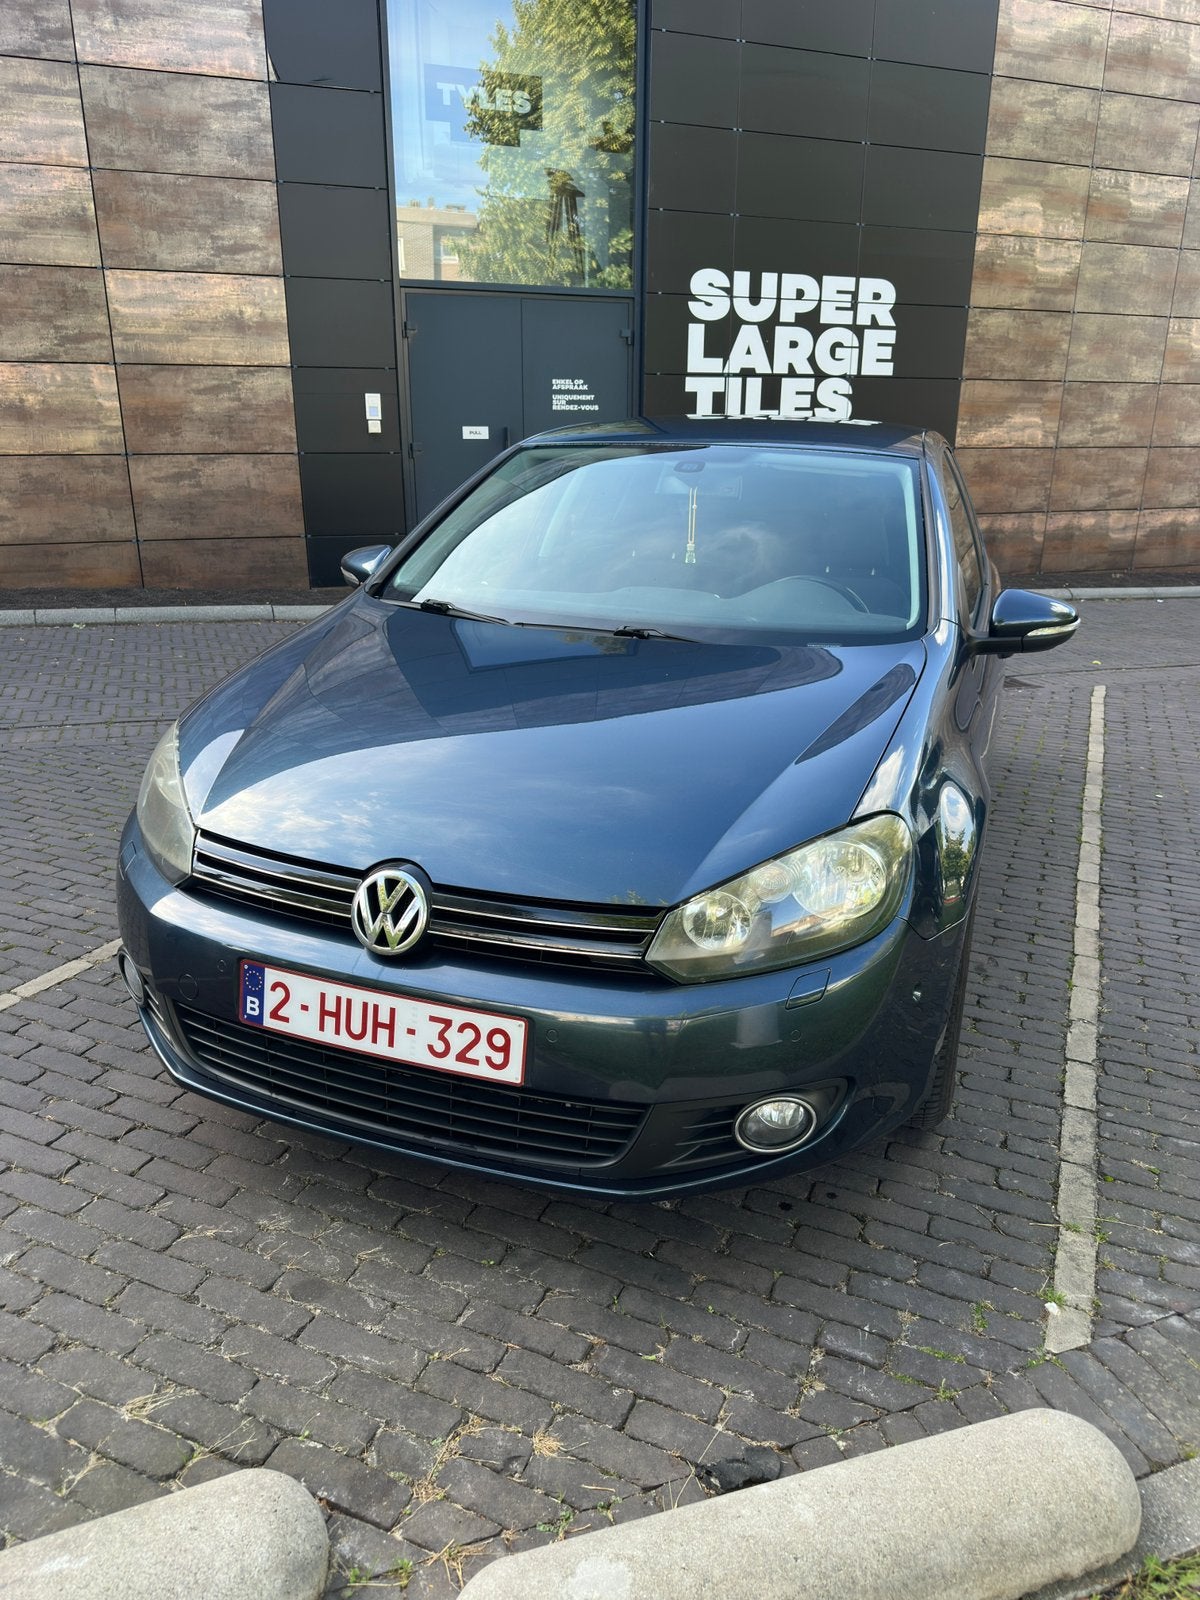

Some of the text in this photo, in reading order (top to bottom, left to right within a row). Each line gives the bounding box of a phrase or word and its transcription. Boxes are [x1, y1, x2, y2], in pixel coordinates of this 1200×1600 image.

[436, 82, 532, 114] TYLES
[688, 268, 897, 326] SUPER
[687, 323, 897, 376] LARGE
[685, 376, 853, 419] TILES
[246, 995, 260, 1016] B
[269, 981, 511, 1071] 2-HUH-329
